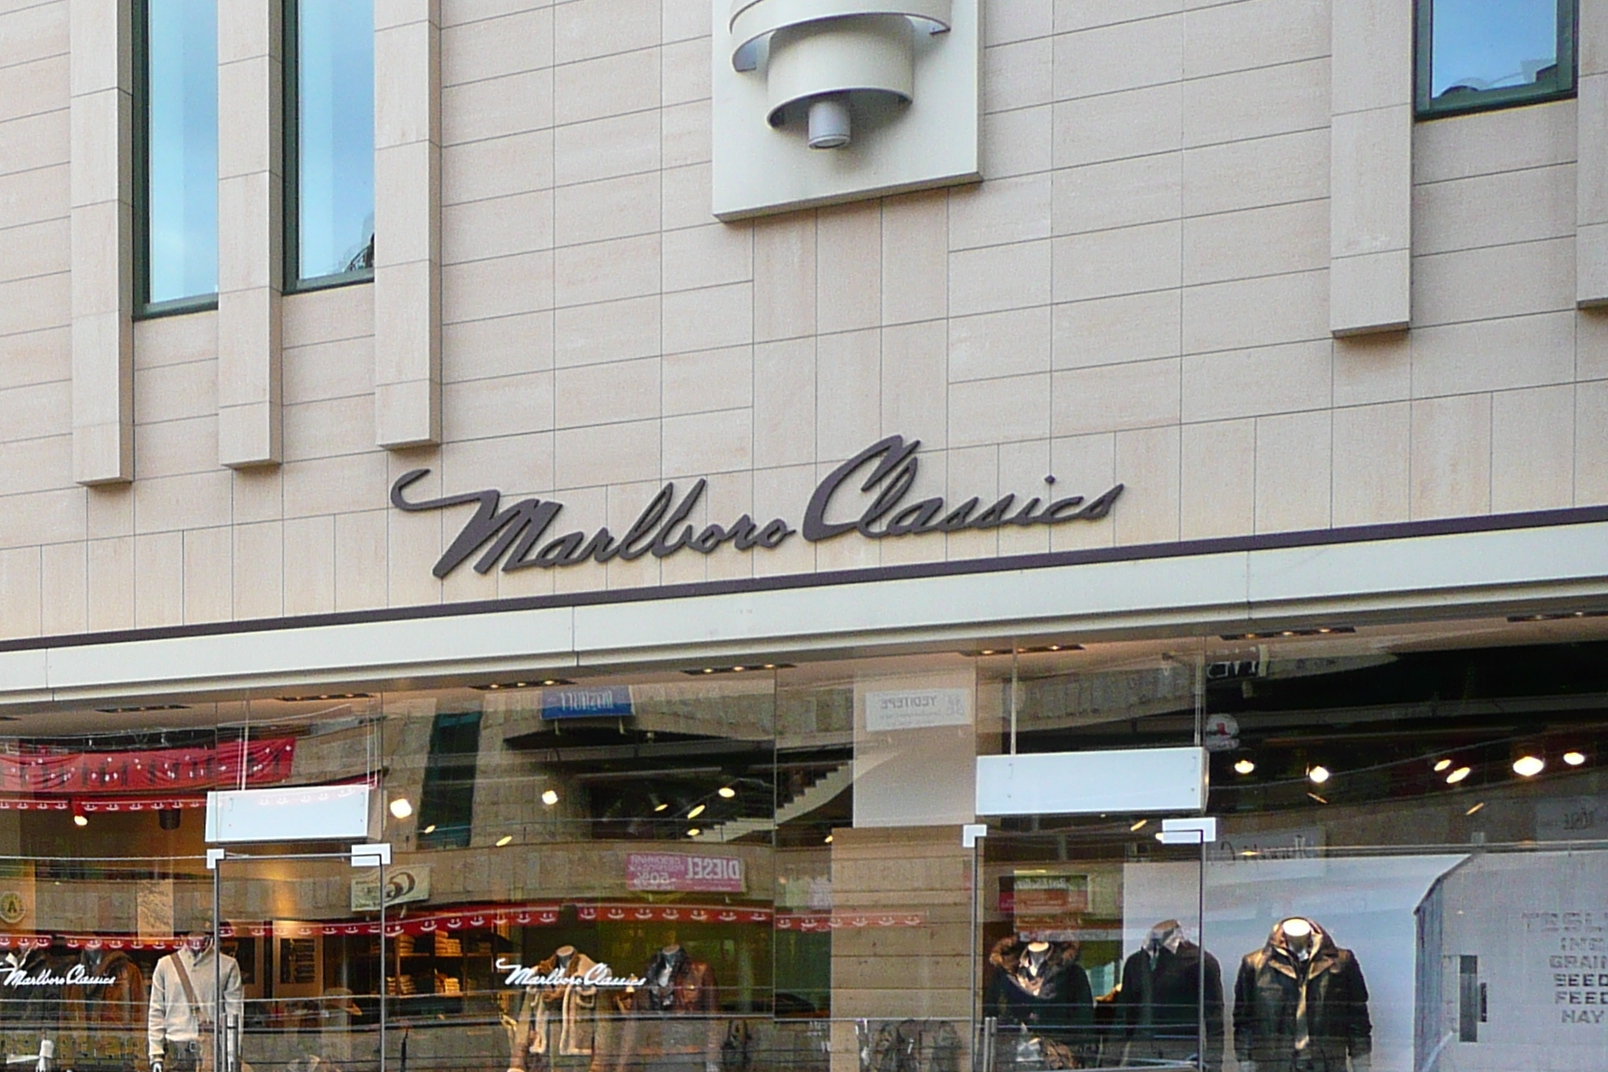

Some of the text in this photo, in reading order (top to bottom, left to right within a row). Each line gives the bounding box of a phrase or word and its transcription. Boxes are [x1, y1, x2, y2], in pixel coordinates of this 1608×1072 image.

[390, 434, 1126, 579] Marlboro Classics
[66, 963, 117, 986] Classics
[495, 958, 647, 986] Marlboro Classics
[1561, 1010, 1605, 1024] HAY
